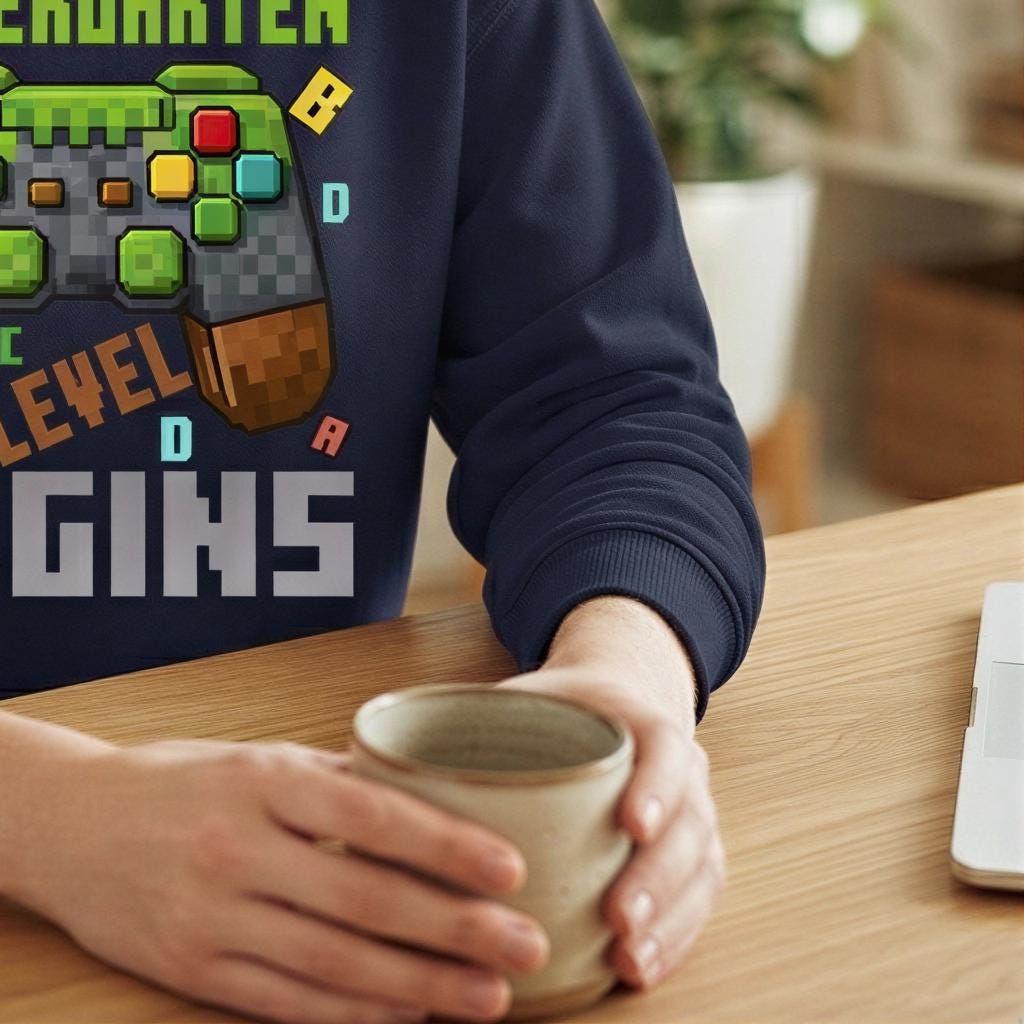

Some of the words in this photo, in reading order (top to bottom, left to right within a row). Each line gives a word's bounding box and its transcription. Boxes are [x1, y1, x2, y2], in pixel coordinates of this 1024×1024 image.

[289, 66, 353, 135] B
[323, 183, 349, 223] D
[161, 416, 192, 462] D
[310, 415, 350, 456] A
